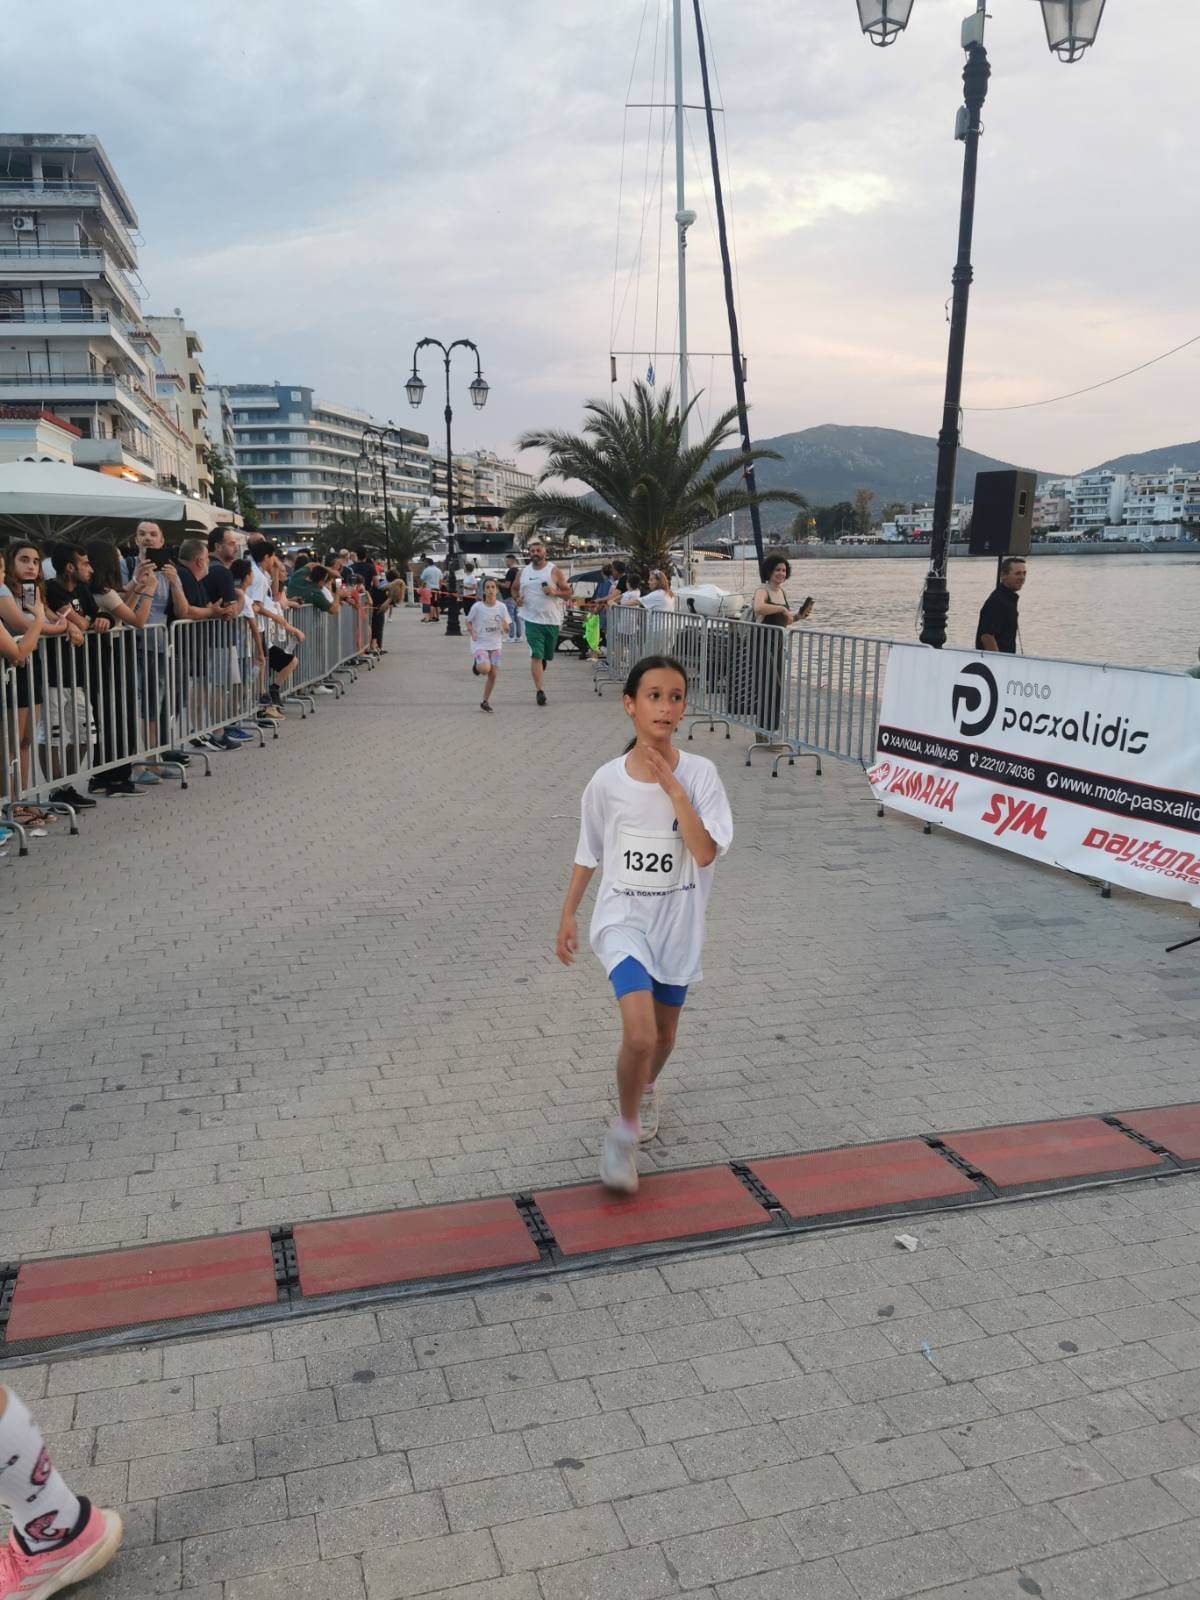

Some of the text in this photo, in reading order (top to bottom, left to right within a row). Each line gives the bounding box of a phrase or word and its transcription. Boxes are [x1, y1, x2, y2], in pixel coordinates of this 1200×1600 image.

[1006, 679, 1052, 700] moto
[1001, 706, 1150, 755] pasxalidis
[947, 748, 959, 762] 95
[979, 755, 1036, 781] 22210 74036
[884, 765, 960, 813] YAMAHA
[981, 793, 1048, 841] SYM
[623, 849, 674, 874] 1326
[1129, 860, 1200, 885] MOTORS
